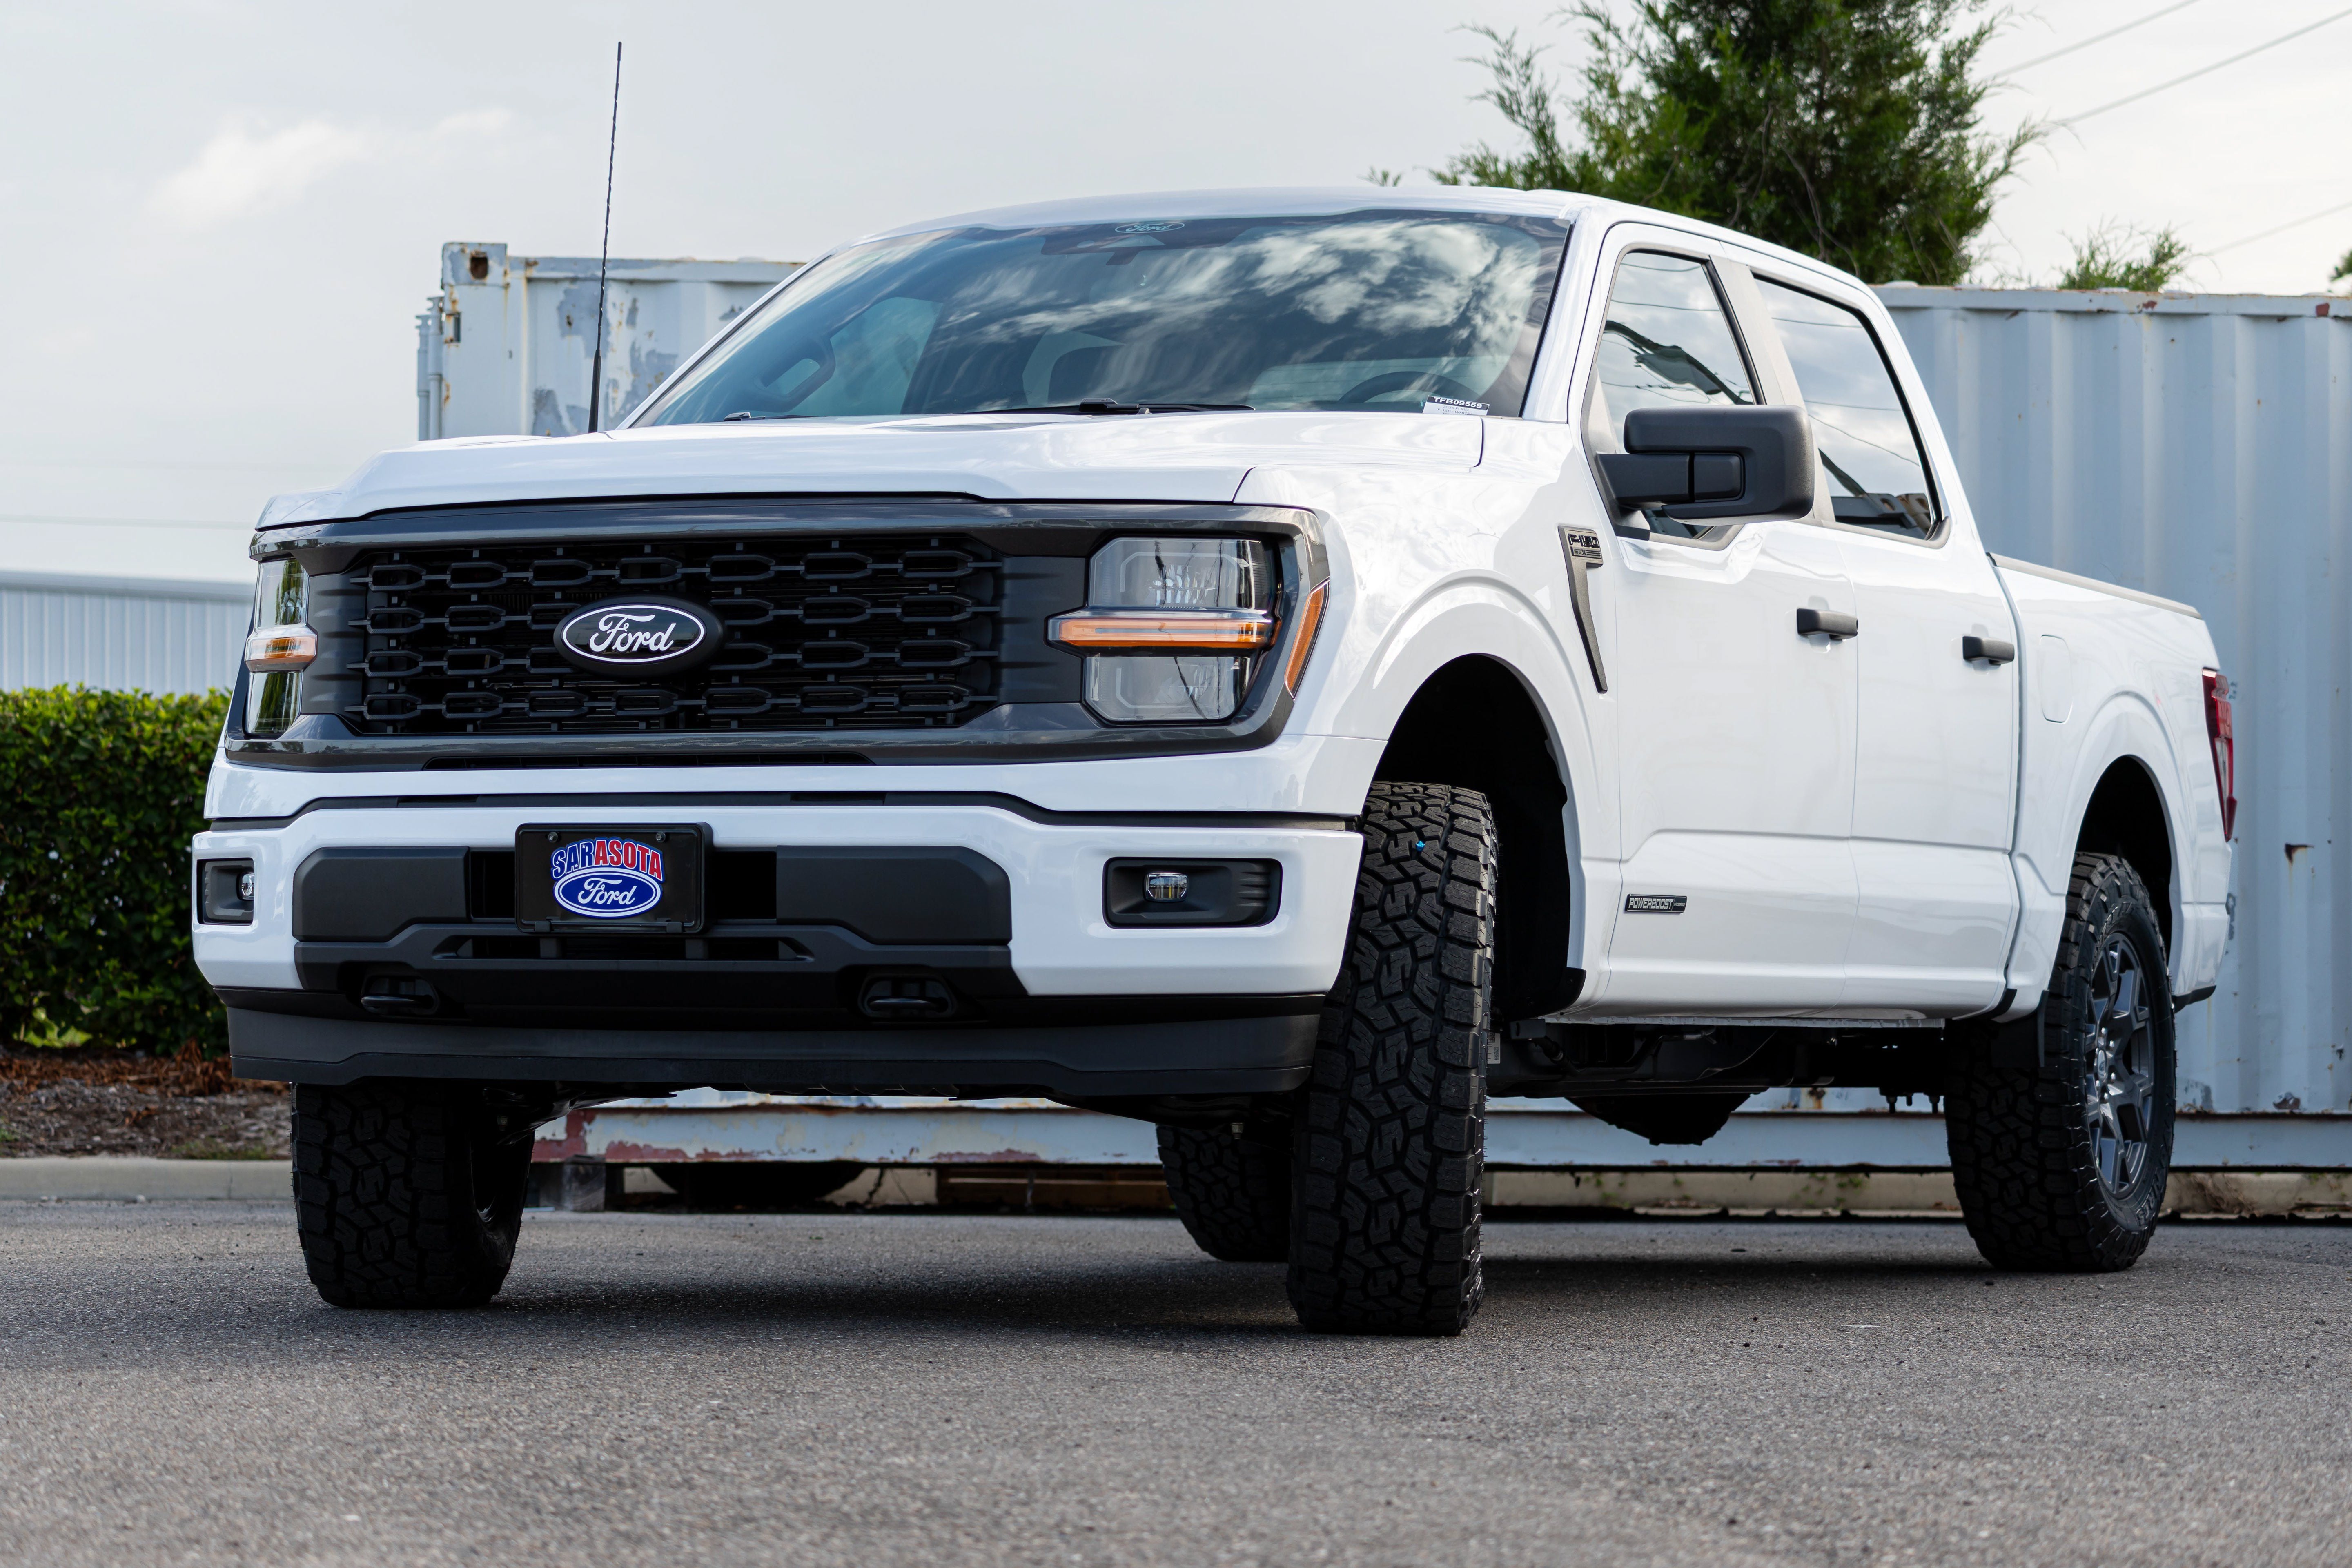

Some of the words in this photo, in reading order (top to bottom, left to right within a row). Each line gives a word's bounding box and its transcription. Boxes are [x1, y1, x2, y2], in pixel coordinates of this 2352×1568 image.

[1126, 223, 1174, 232] Ford
[1434, 396, 1482, 408] TFB09559
[1567, 533, 1600, 548] F-150
[589, 613, 677, 652] Ford
[552, 839, 663, 882] SARASOTA
[578, 878, 637, 905] Ford
[1628, 898, 1674, 909] POWERBOOST
